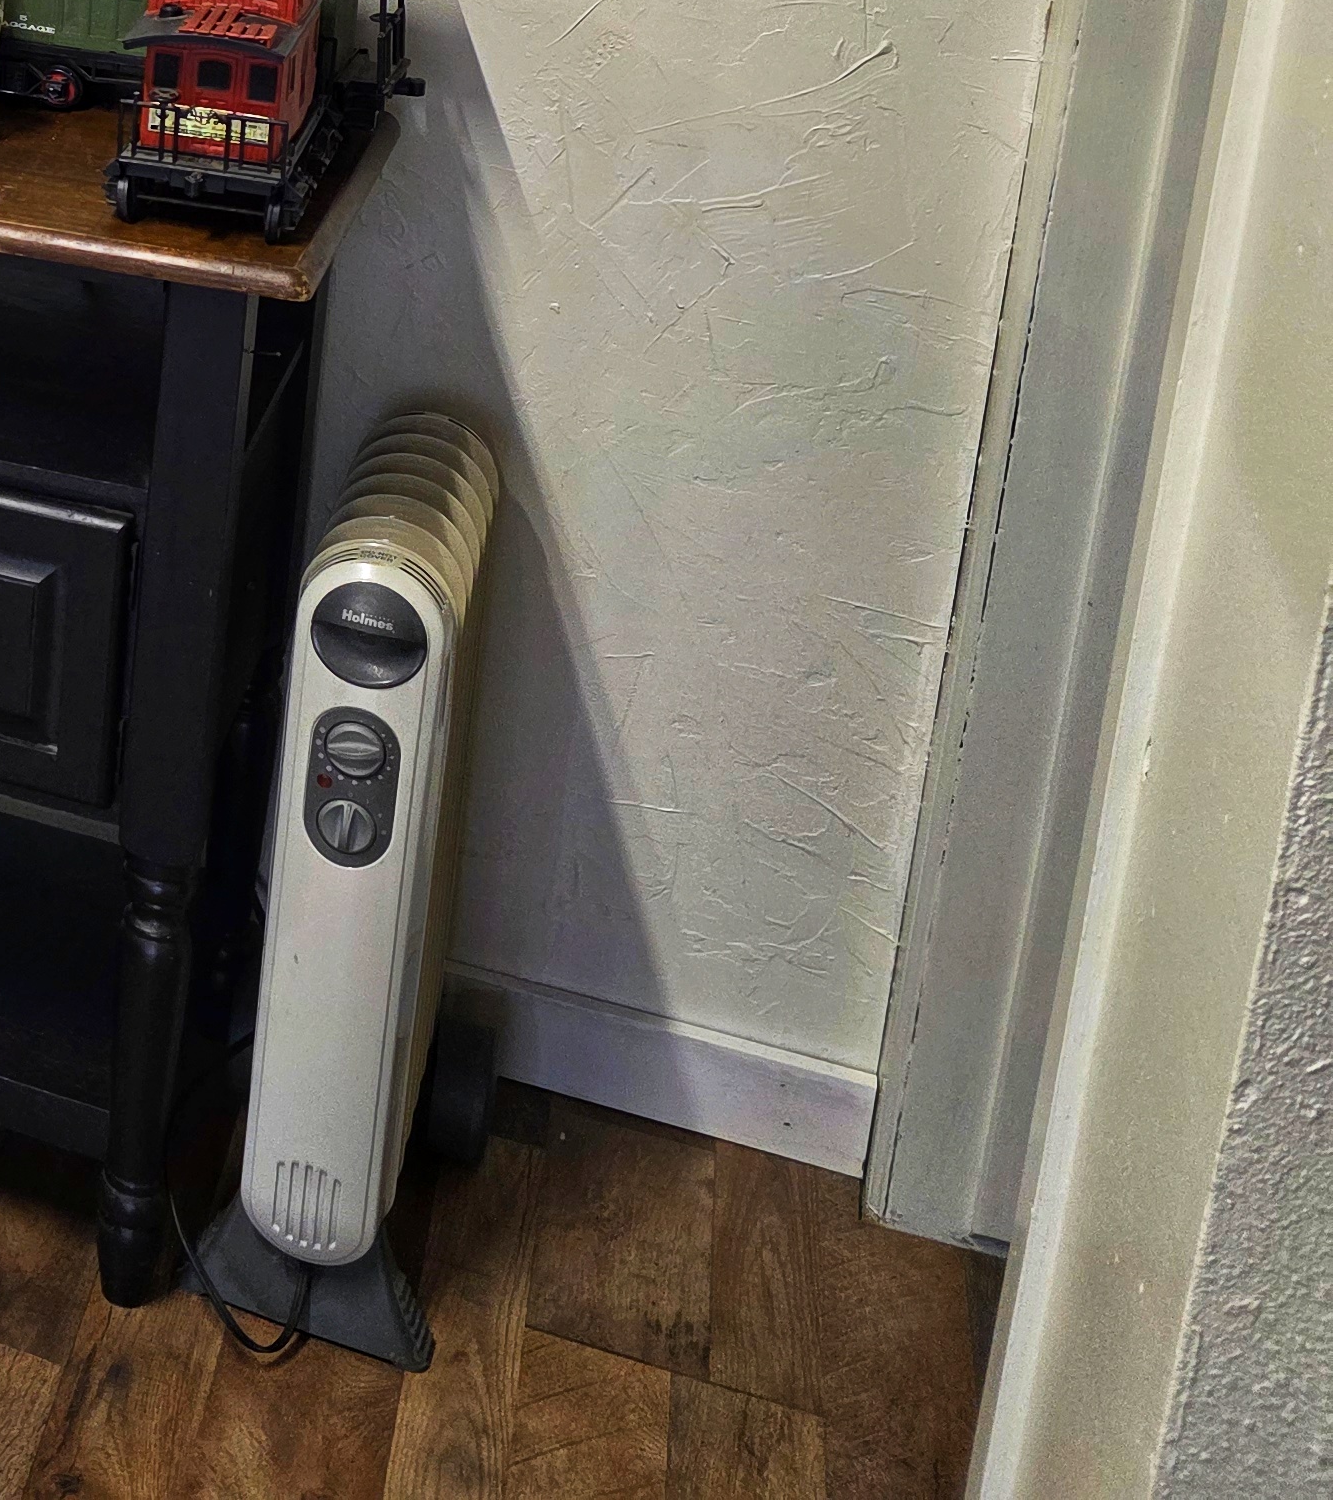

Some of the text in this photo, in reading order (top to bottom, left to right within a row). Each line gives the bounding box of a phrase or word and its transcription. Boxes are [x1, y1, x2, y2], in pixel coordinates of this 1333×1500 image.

[19, 14, 28, 22] 5
[1, 20, 56, 34] AGGAGE
[342, 609, 394, 630] Holmes
